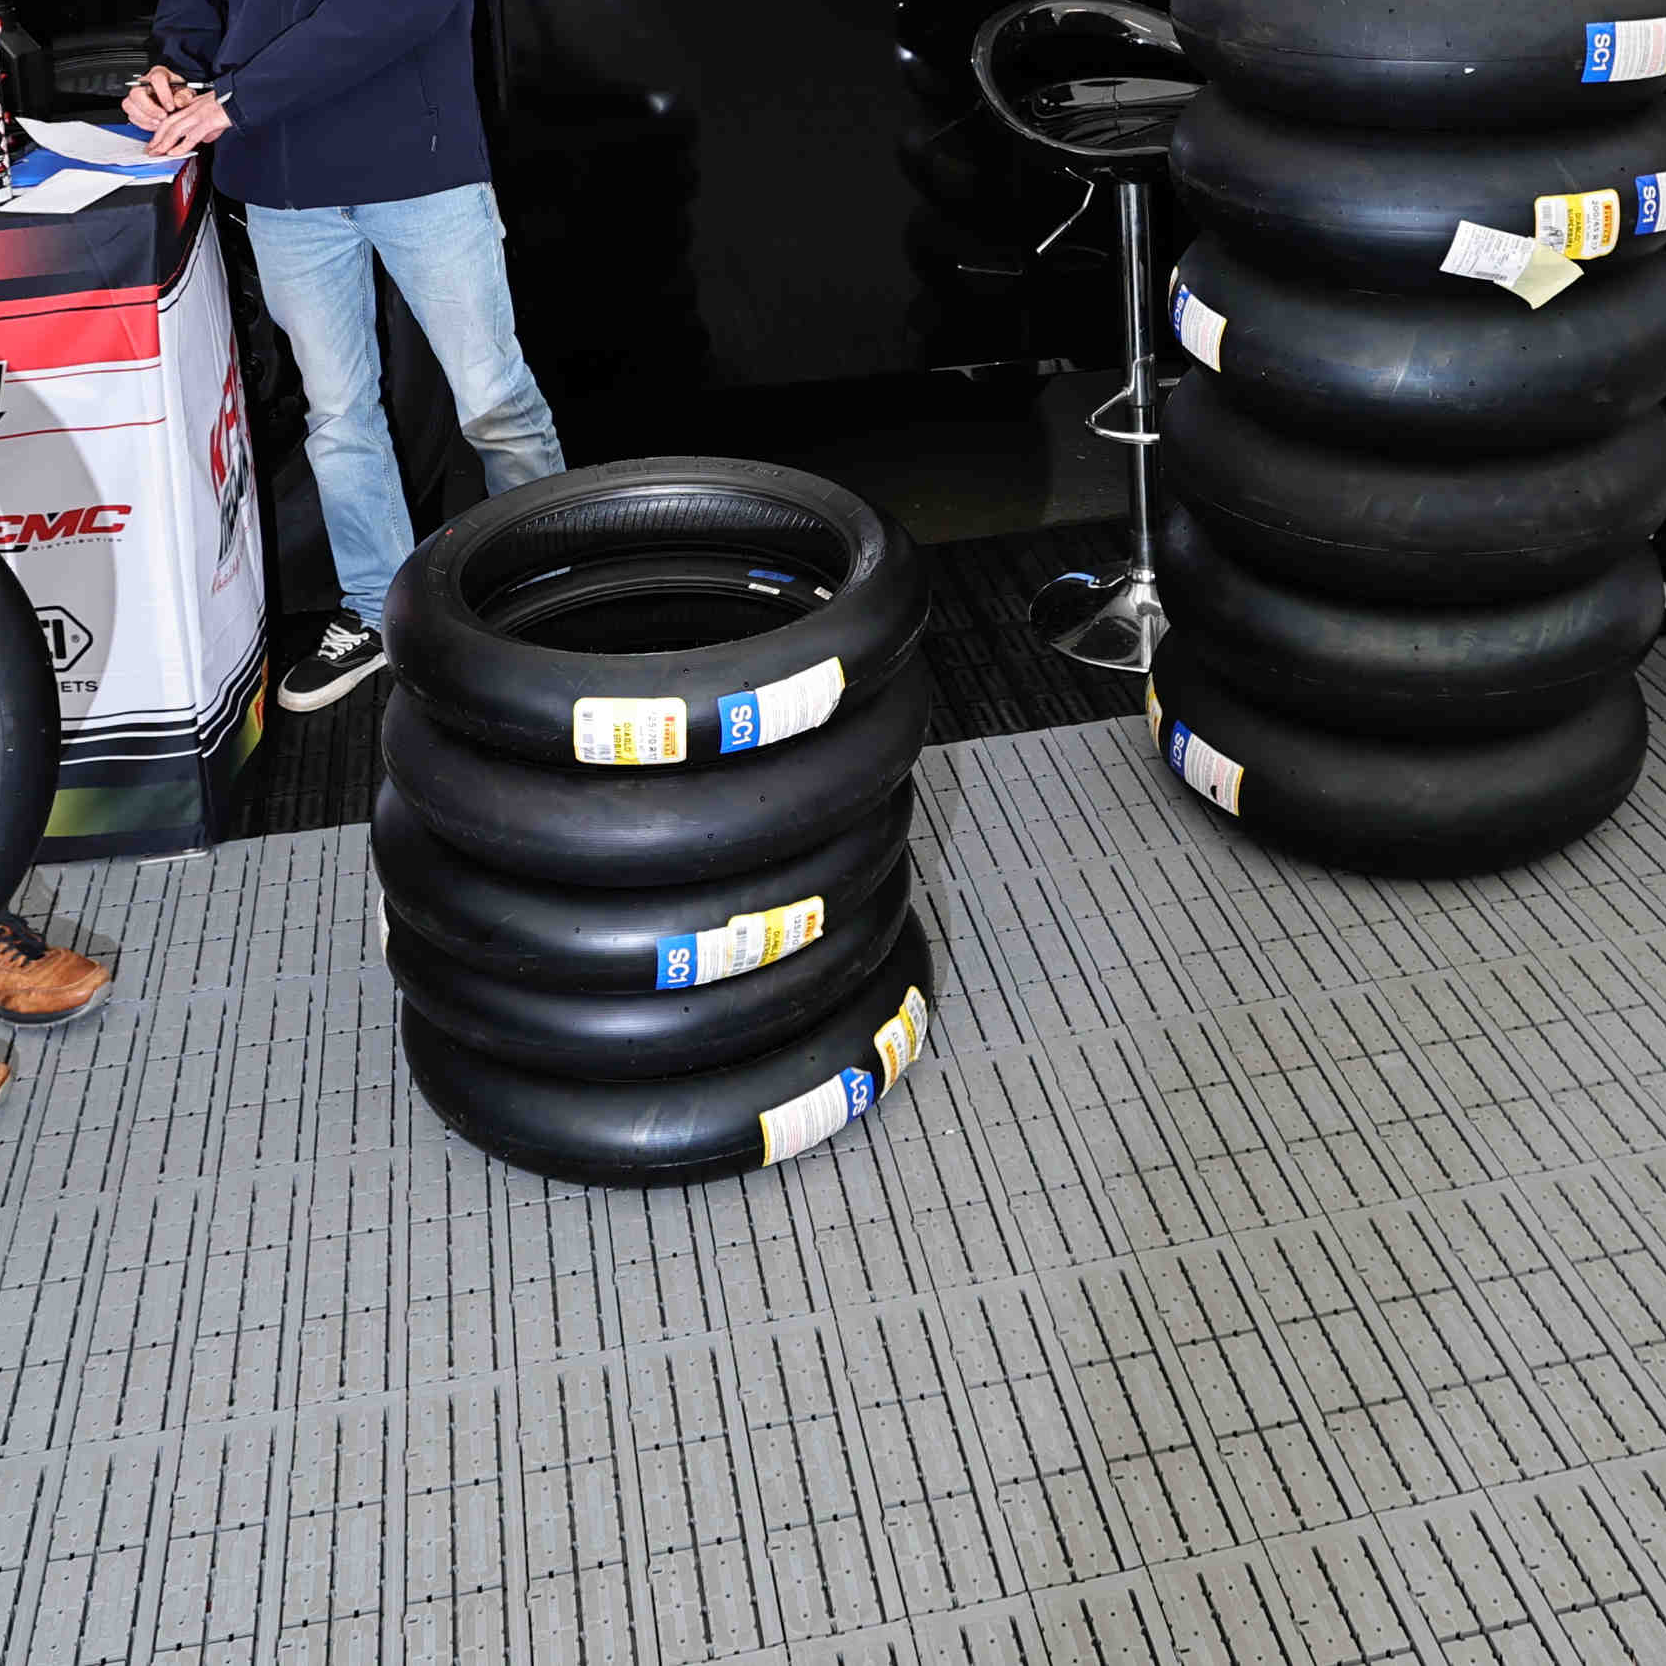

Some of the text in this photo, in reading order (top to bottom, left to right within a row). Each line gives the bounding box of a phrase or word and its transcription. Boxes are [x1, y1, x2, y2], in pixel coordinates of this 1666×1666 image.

[1591, 32, 1611, 71] SC1
[1642, 186, 1656, 223] SC1
[730, 705, 752, 745] SC1
[1173, 732, 1185, 768] SC1
[667, 947, 691, 984] SC1
[850, 1074, 868, 1117] SC1
